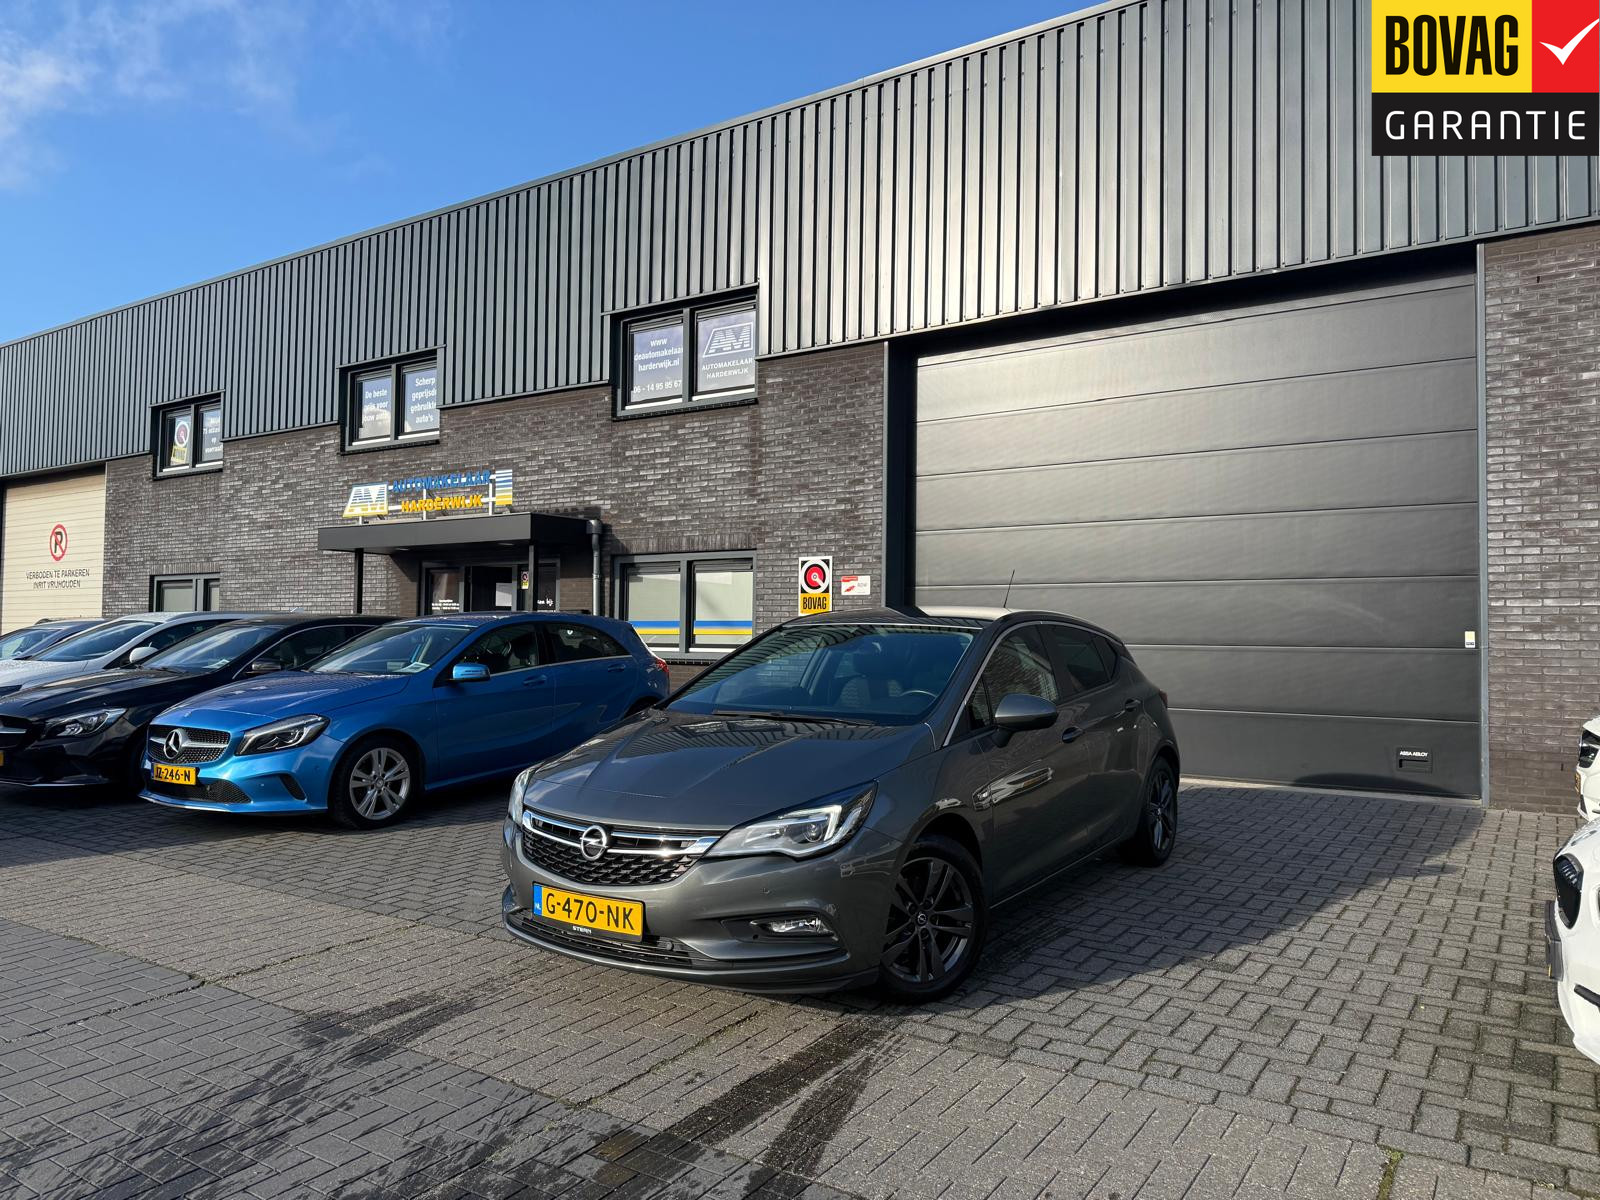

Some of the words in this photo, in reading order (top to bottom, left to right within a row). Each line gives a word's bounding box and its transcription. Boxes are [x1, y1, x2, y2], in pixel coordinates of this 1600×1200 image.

[650, 337, 668, 347] www
[638, 358, 680, 372] harderwijk.nl
[701, 357, 753, 371] AUTOMAKELAAR
[706, 367, 749, 379] HARDERWIJK
[415, 377, 436, 387] Scherp
[365, 391, 372, 399] De
[373, 389, 388, 398] beste
[392, 469, 492, 493] AUTOMAKELAAR
[401, 494, 483, 513] HARDERWIJK
[26, 570, 53, 580] VERBODEN
[54, 570, 60, 578] TE
[61, 568, 90, 578] PARKEREN
[33, 580, 47, 589] INRIT
[47, 579, 81, 589] VRIJHOUDEN
[802, 596, 827, 610] BOVAG
[546, 893, 635, 931] G-470-NK
